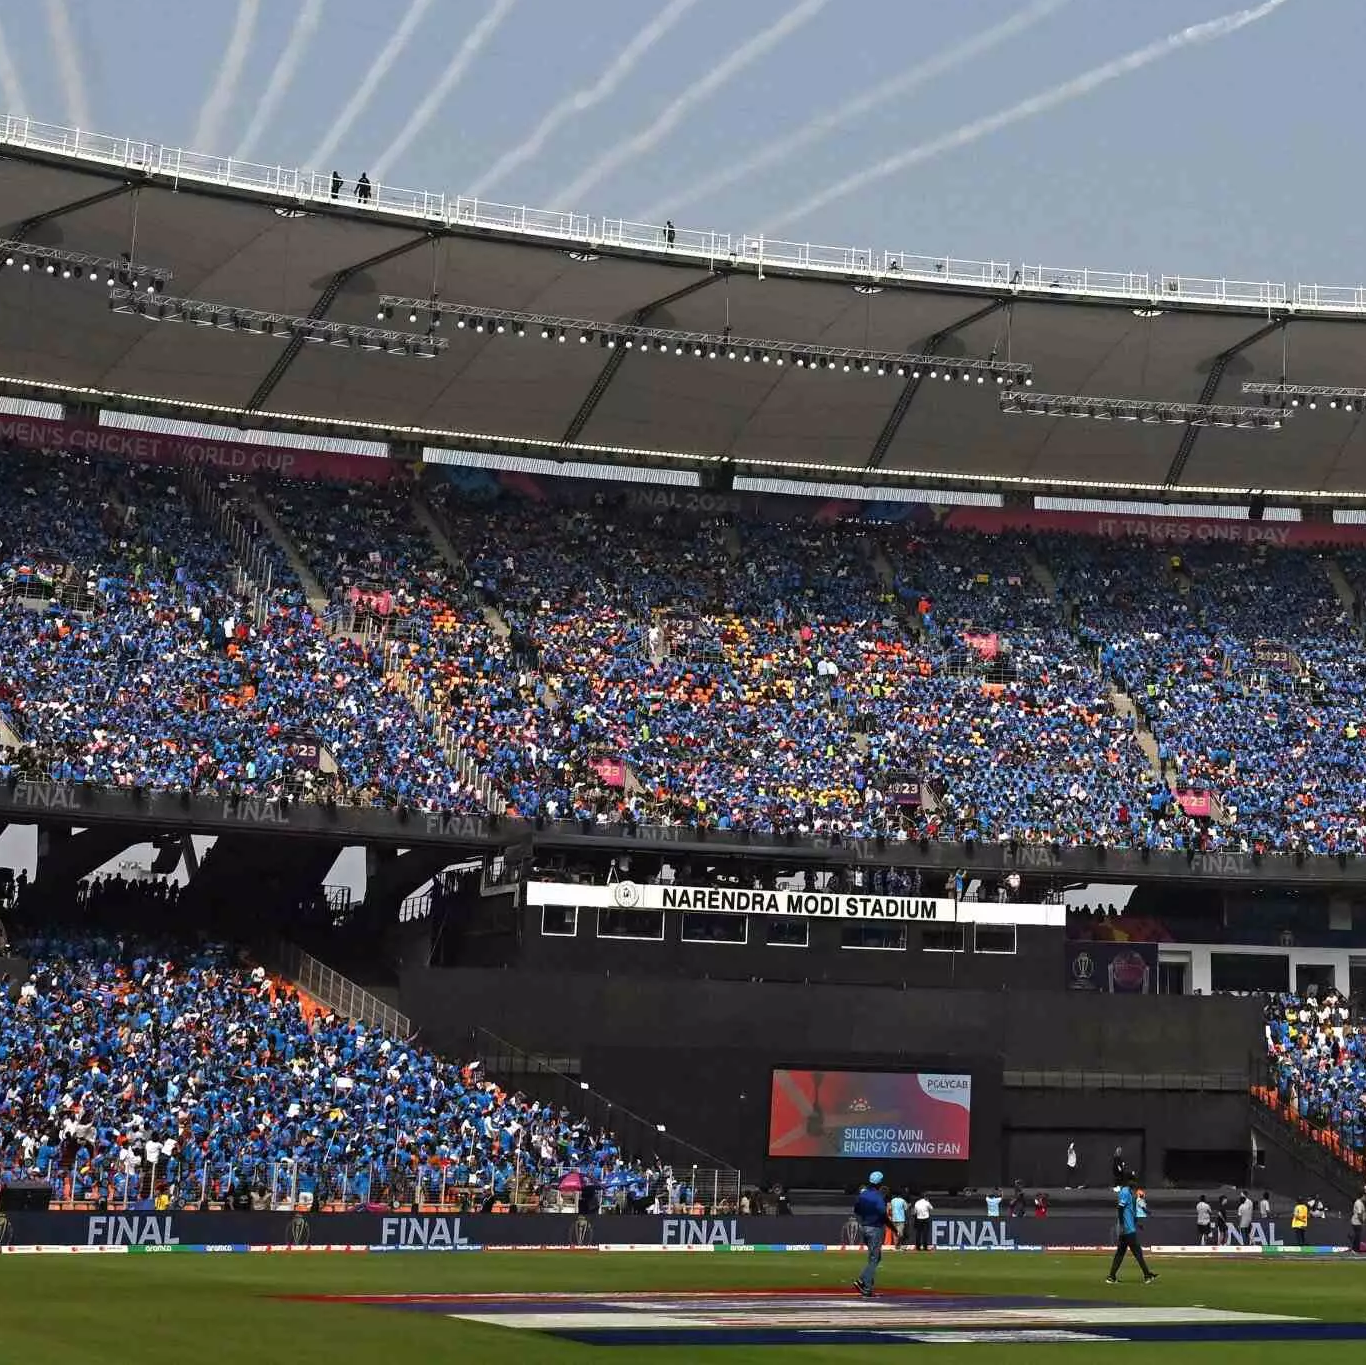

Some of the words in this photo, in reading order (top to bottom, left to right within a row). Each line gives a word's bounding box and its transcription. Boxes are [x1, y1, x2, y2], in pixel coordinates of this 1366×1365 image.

[69, 427, 162, 458] CRICKET
[251, 452, 296, 471] CUP
[1098, 519, 1118, 536] IT
[1120, 520, 1192, 540] TAKES
[1247, 525, 1291, 543] DAY
[14, 783, 81, 809] FINAL
[222, 799, 289, 823] FINAL
[426, 815, 492, 838] FINAL
[1002, 846, 1063, 867] FINAL
[1191, 856, 1251, 874] FINAL
[662, 888, 779, 913] NARENDRA
[786, 893, 839, 916] MODI
[845, 897, 936, 919] STADIUM
[927, 1079, 969, 1090] POLYCAB
[844, 1128, 896, 1141] SILENCIO
[897, 1129, 923, 1141] MINI
[843, 1141, 890, 1154] ENERGY
[891, 1142, 935, 1154] SAVING
[937, 1143, 961, 1155] FAN
[88, 1215, 180, 1245] FINAL
[381, 1217, 468, 1245] FINAL
[662, 1219, 745, 1246] FINAL
[932, 1220, 1015, 1246] FINAL
[206, 1244, 233, 1252] aramco
